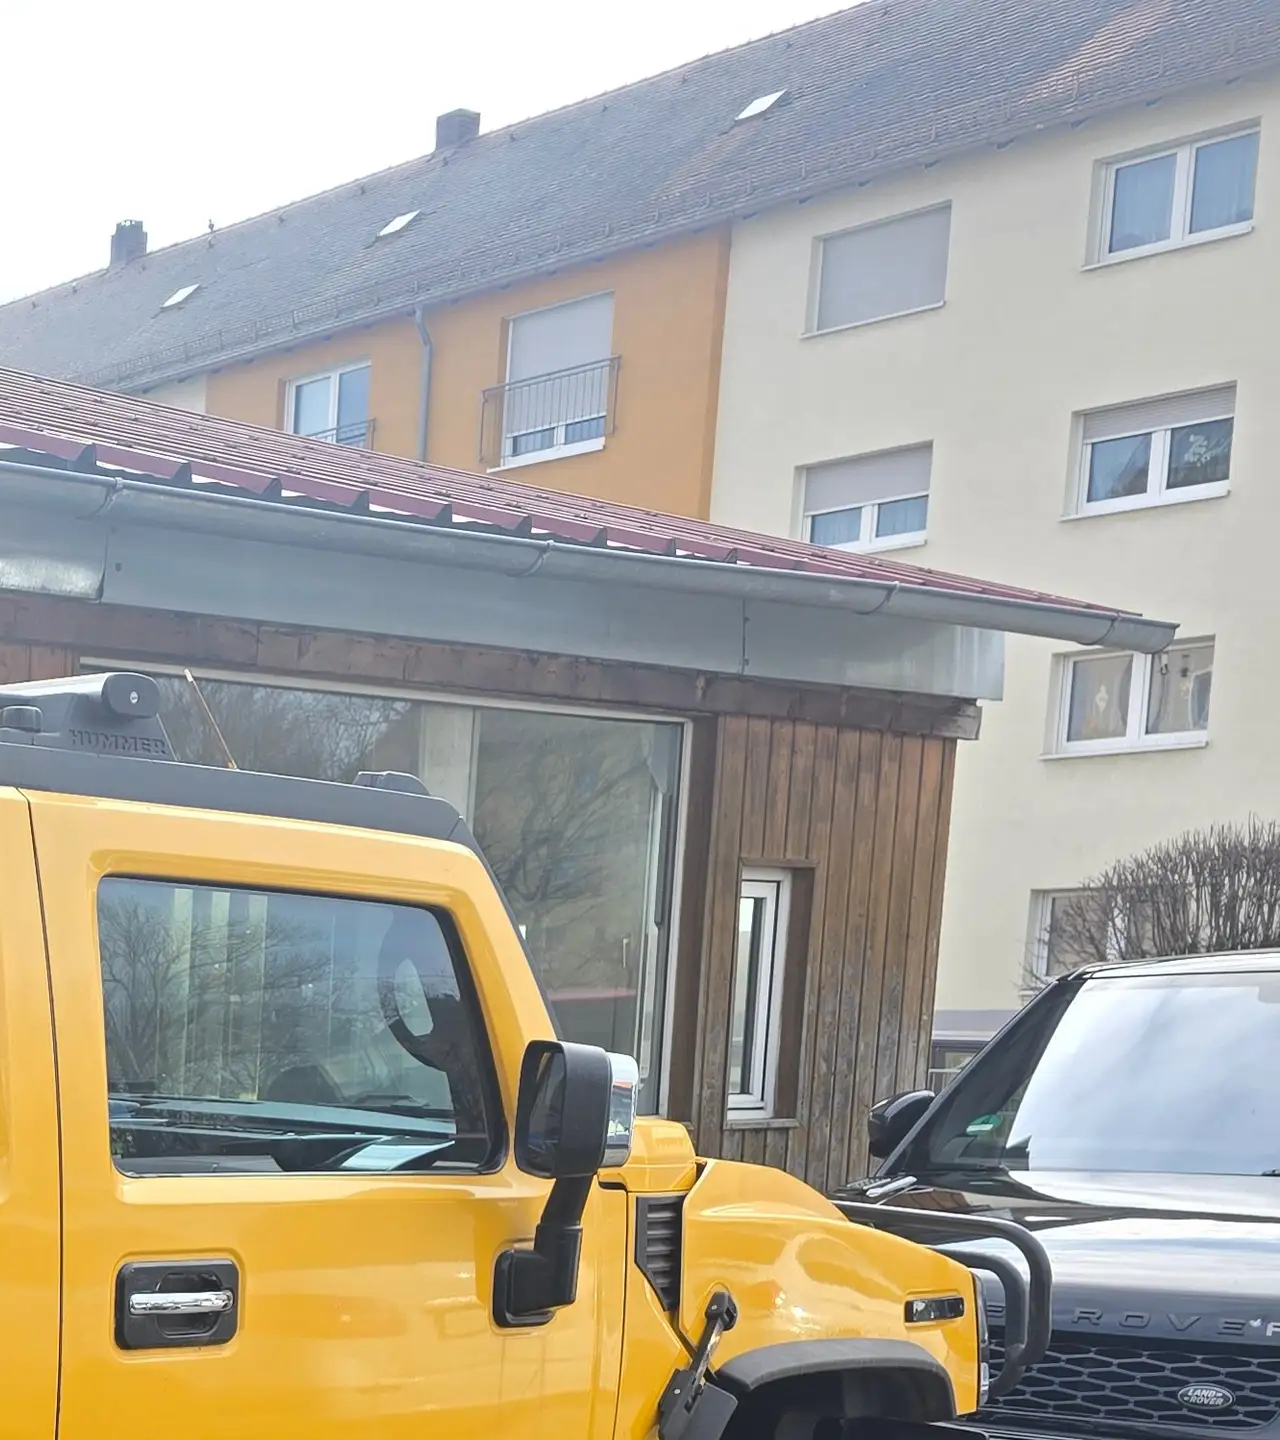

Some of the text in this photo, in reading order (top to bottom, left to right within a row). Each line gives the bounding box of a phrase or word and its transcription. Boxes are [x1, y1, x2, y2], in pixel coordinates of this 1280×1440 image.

[68, 728, 168, 756] HUMMER
[1187, 1388, 1216, 1398] LAND
[1189, 1395, 1225, 1406] ROVER
